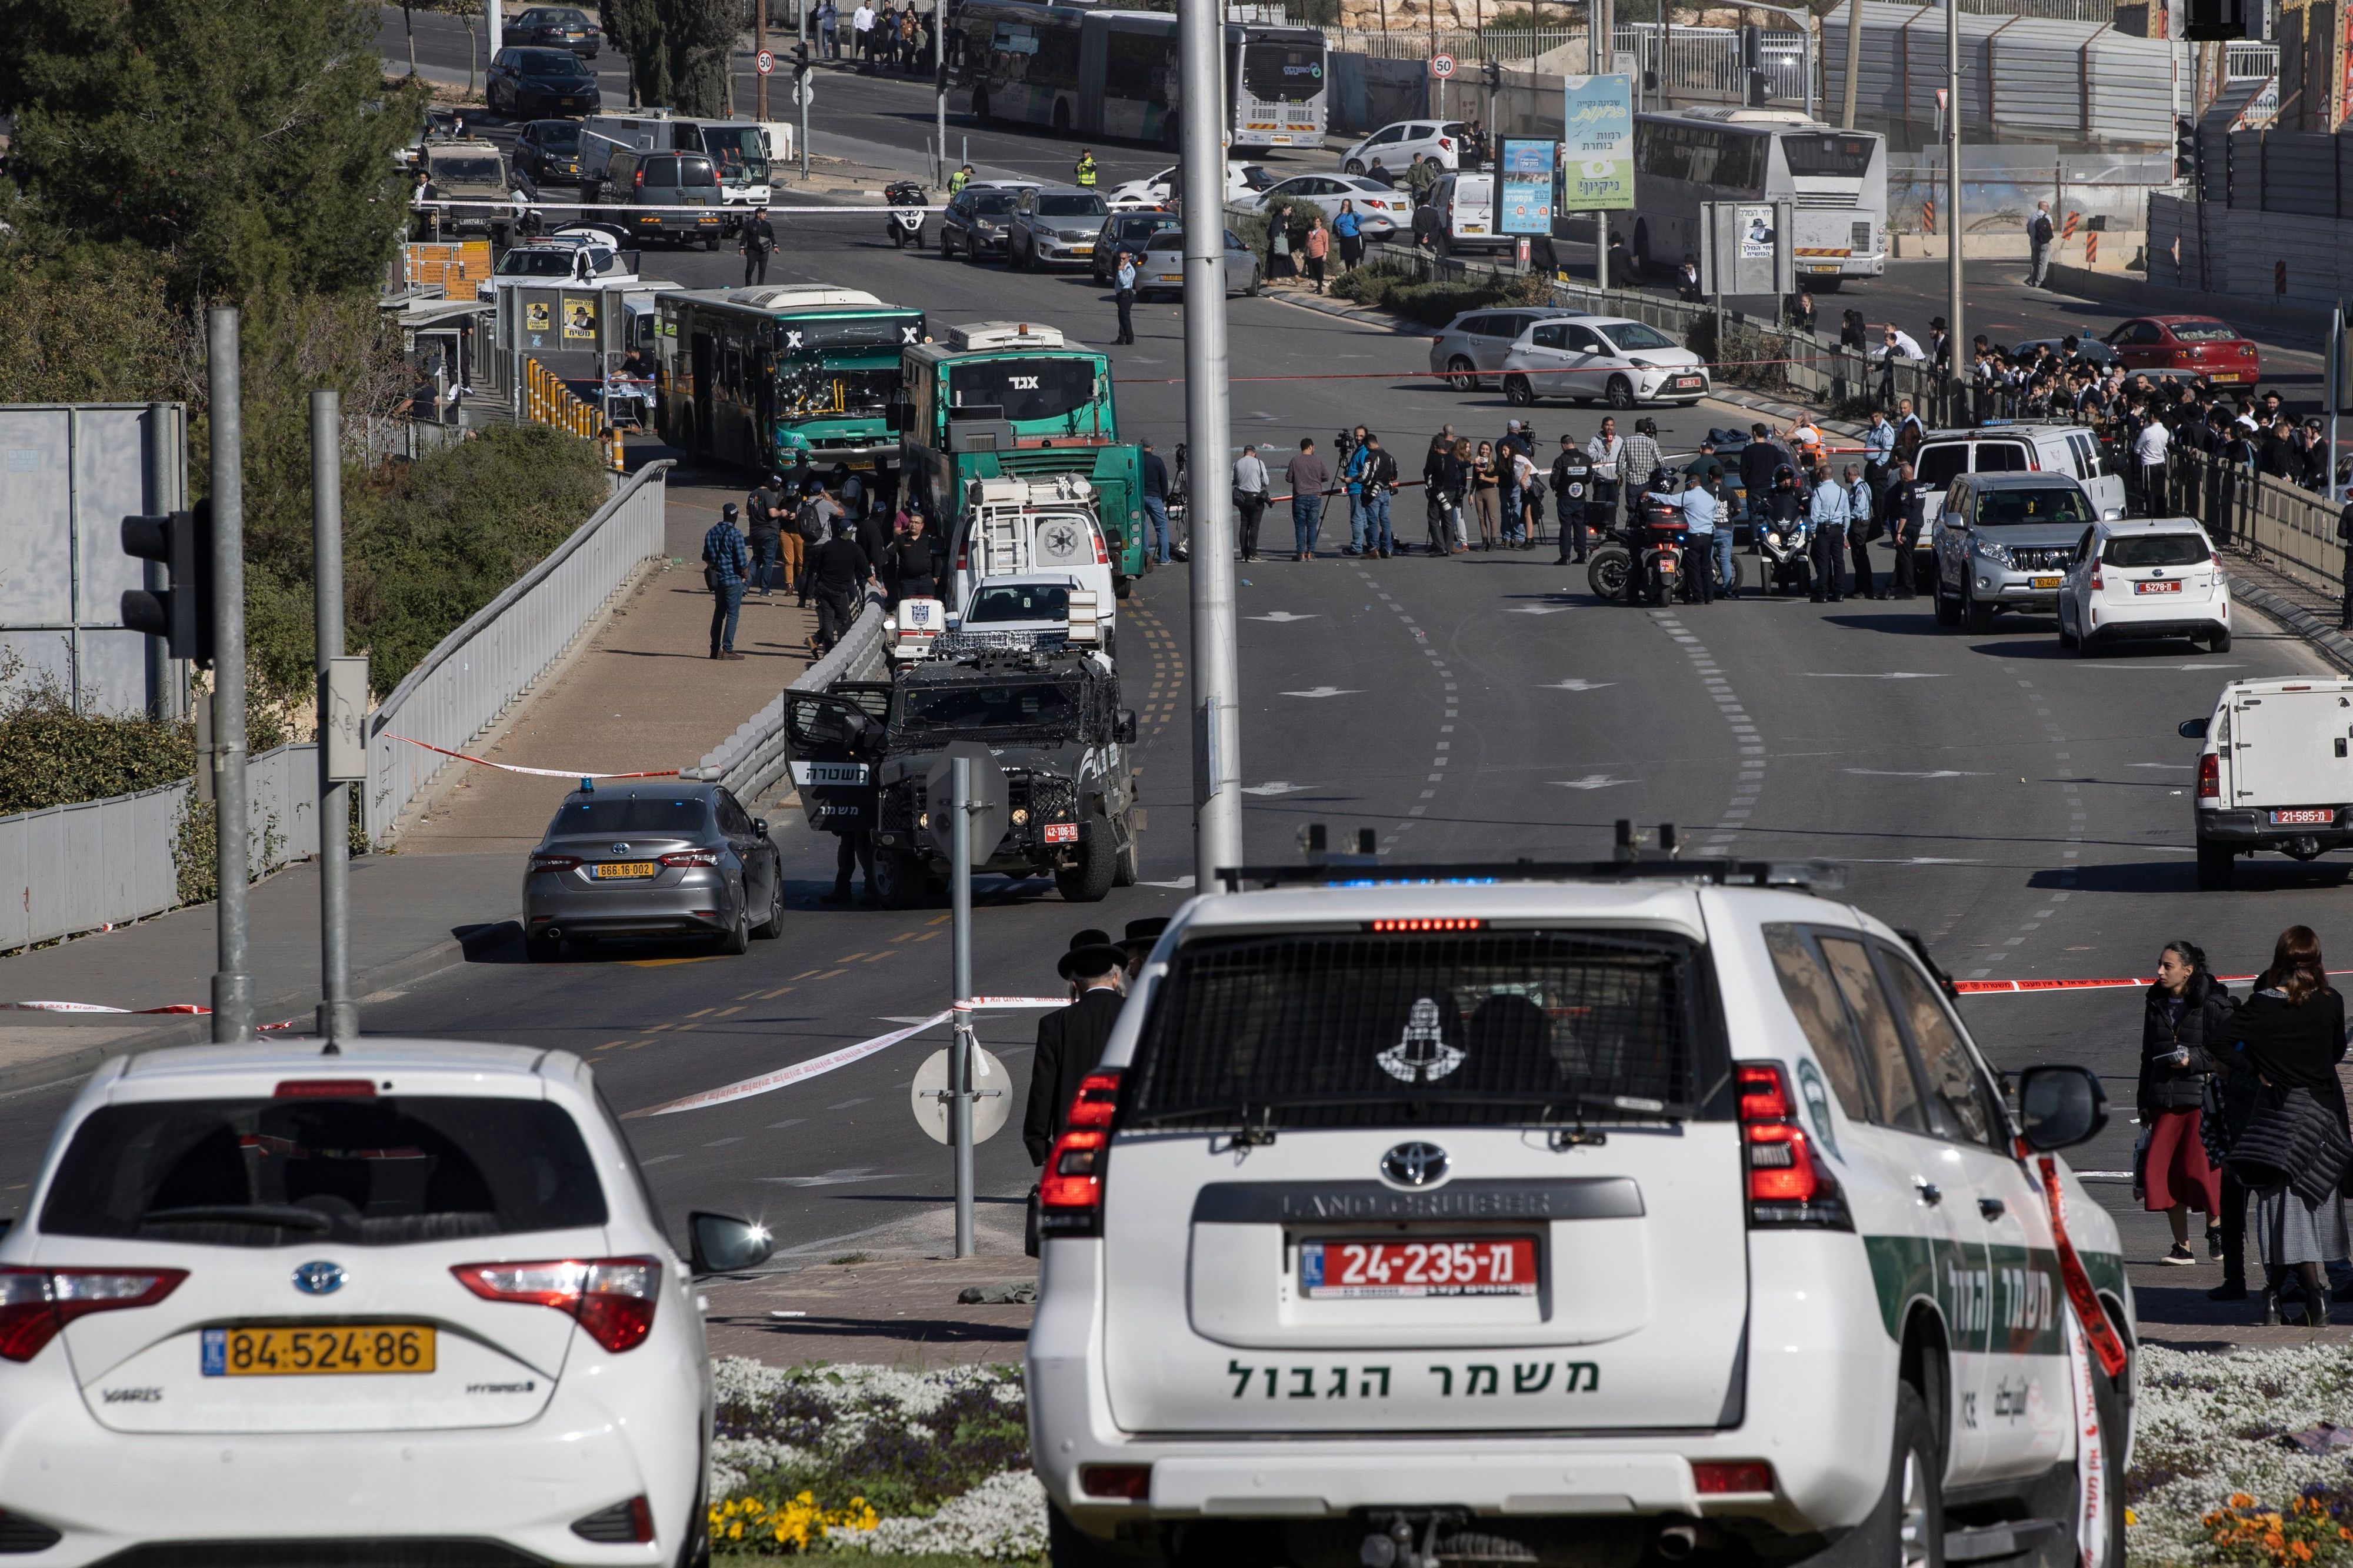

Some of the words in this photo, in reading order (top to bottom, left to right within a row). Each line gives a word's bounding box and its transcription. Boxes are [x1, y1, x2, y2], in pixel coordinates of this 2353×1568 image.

[760, 56, 771, 68] 50
[1437, 61, 1451, 71] 50
[1597, 131, 1621, 140] רמות
[1582, 142, 1613, 151] בוחרת
[1579, 181, 1620, 196] ניקיון!
[1008, 376, 1039, 389] אגד
[805, 768, 868, 781] משטרה
[819, 806, 859, 815] משמר
[1283, 1194, 1377, 1217] LAND
[1391, 1193, 1551, 1216] CRUISER
[1228, 1360, 1391, 1399] הגבול
[1429, 1360, 1601, 1397] משמר
[102, 1386, 162, 1404] YARIS
